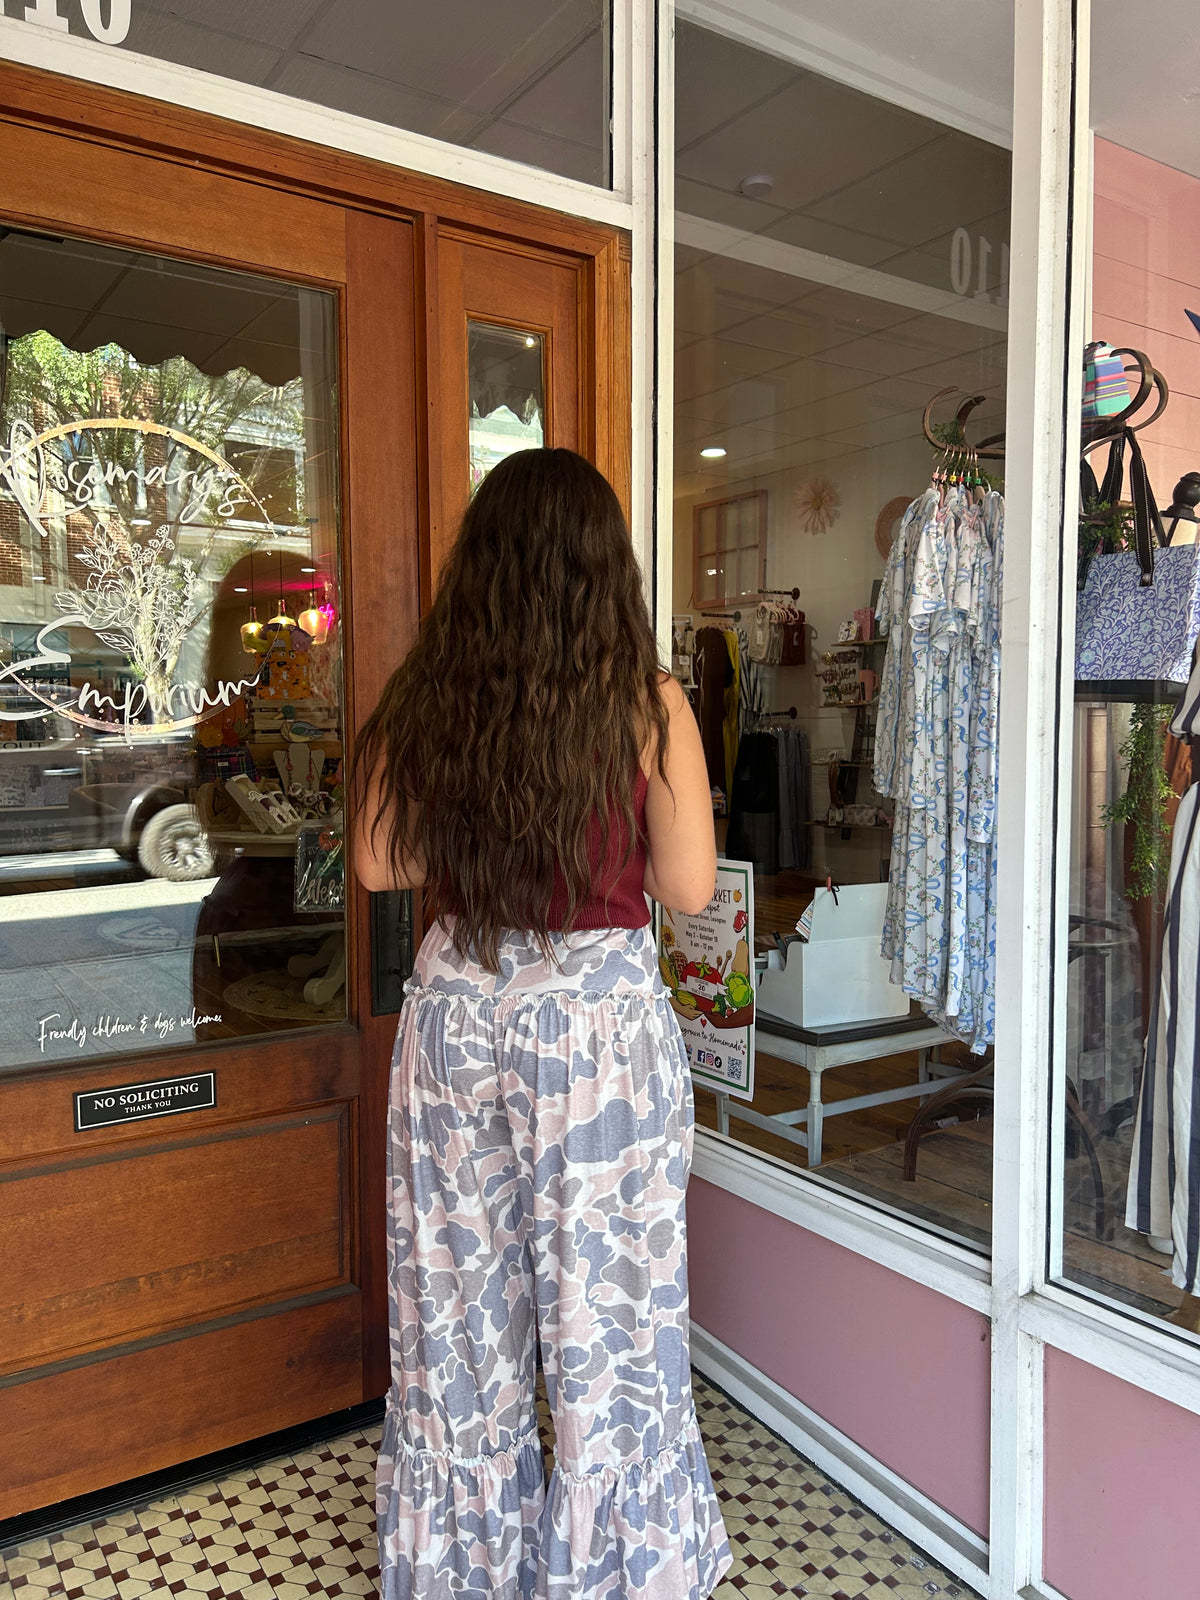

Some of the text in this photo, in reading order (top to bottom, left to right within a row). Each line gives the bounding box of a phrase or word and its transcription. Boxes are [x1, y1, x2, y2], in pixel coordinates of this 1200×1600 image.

[0, 420, 251, 537] Rosemary's
[0, 615, 264, 746] Emporium
[711, 888, 731, 904] RKET
[698, 924, 715, 935] Saturday
[140, 1014, 149, 1034] &
[154, 1012, 176, 1039] dogs
[708, 1032, 741, 1051] Homemade
[94, 1082, 199, 1110] NO SOLICITING
[124, 1099, 172, 1114] THANK YOU
